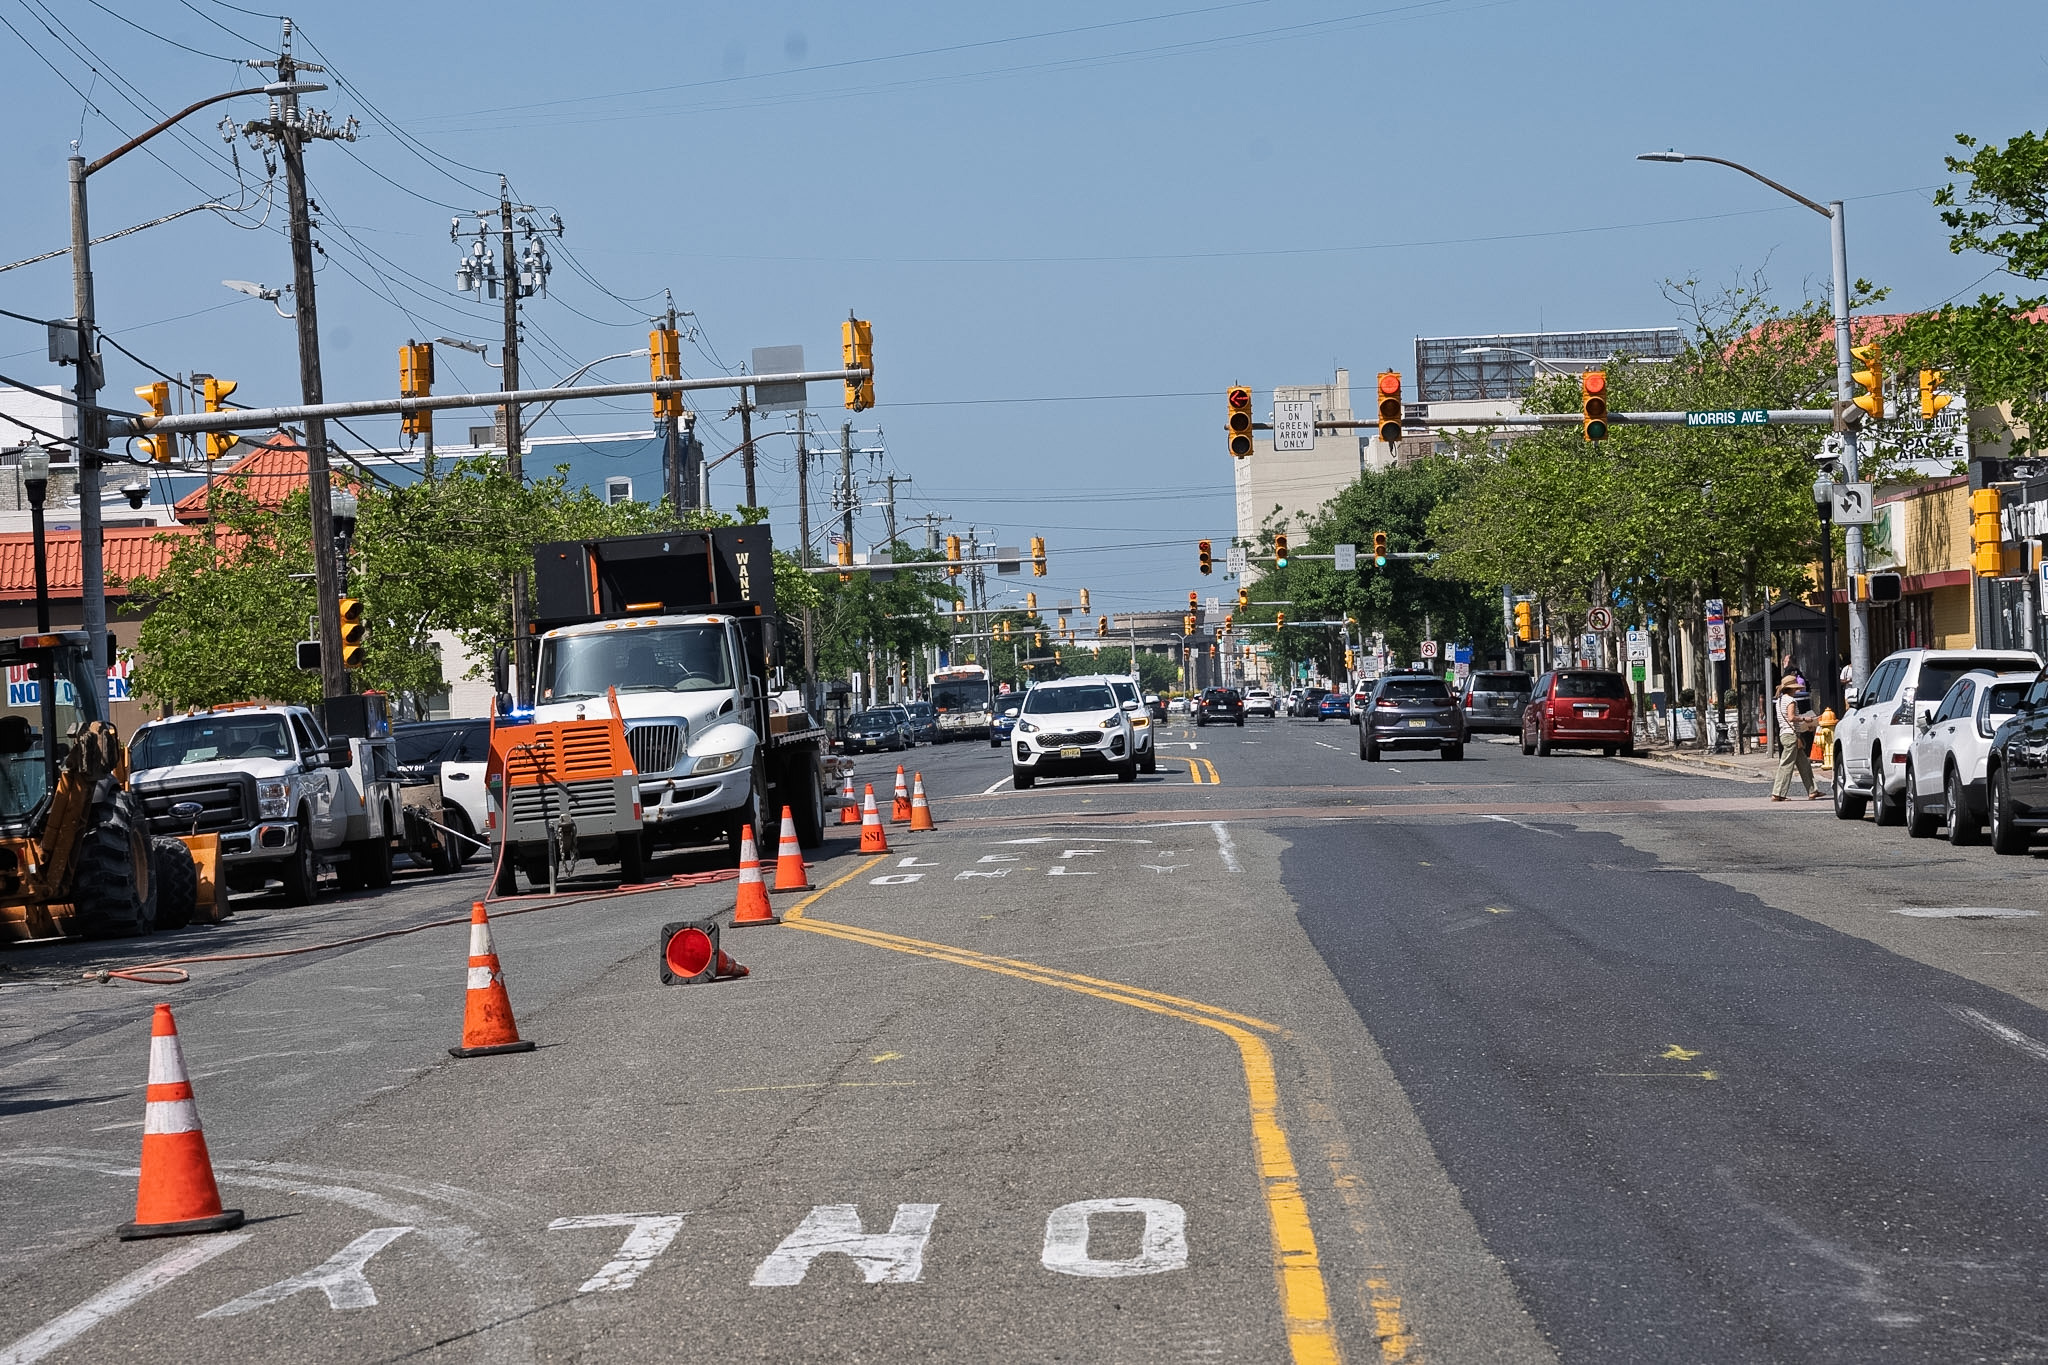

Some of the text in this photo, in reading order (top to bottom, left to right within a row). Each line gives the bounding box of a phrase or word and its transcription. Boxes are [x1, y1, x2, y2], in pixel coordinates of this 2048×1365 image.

[1283, 403, 1304, 412] LEFT
[1288, 412, 1300, 421] ON
[1688, 411, 1767, 425] MORRIS AVE.
[1280, 421, 1309, 430] GREEN
[1280, 430, 1309, 440] ARROW
[1283, 440, 1305, 449] ONLY
[63, 678, 131, 702] OEN
[864, 831, 880, 842] SSI
[869, 863, 1190, 885] ONLY
[196, 1196, 1189, 1320] ONLY
